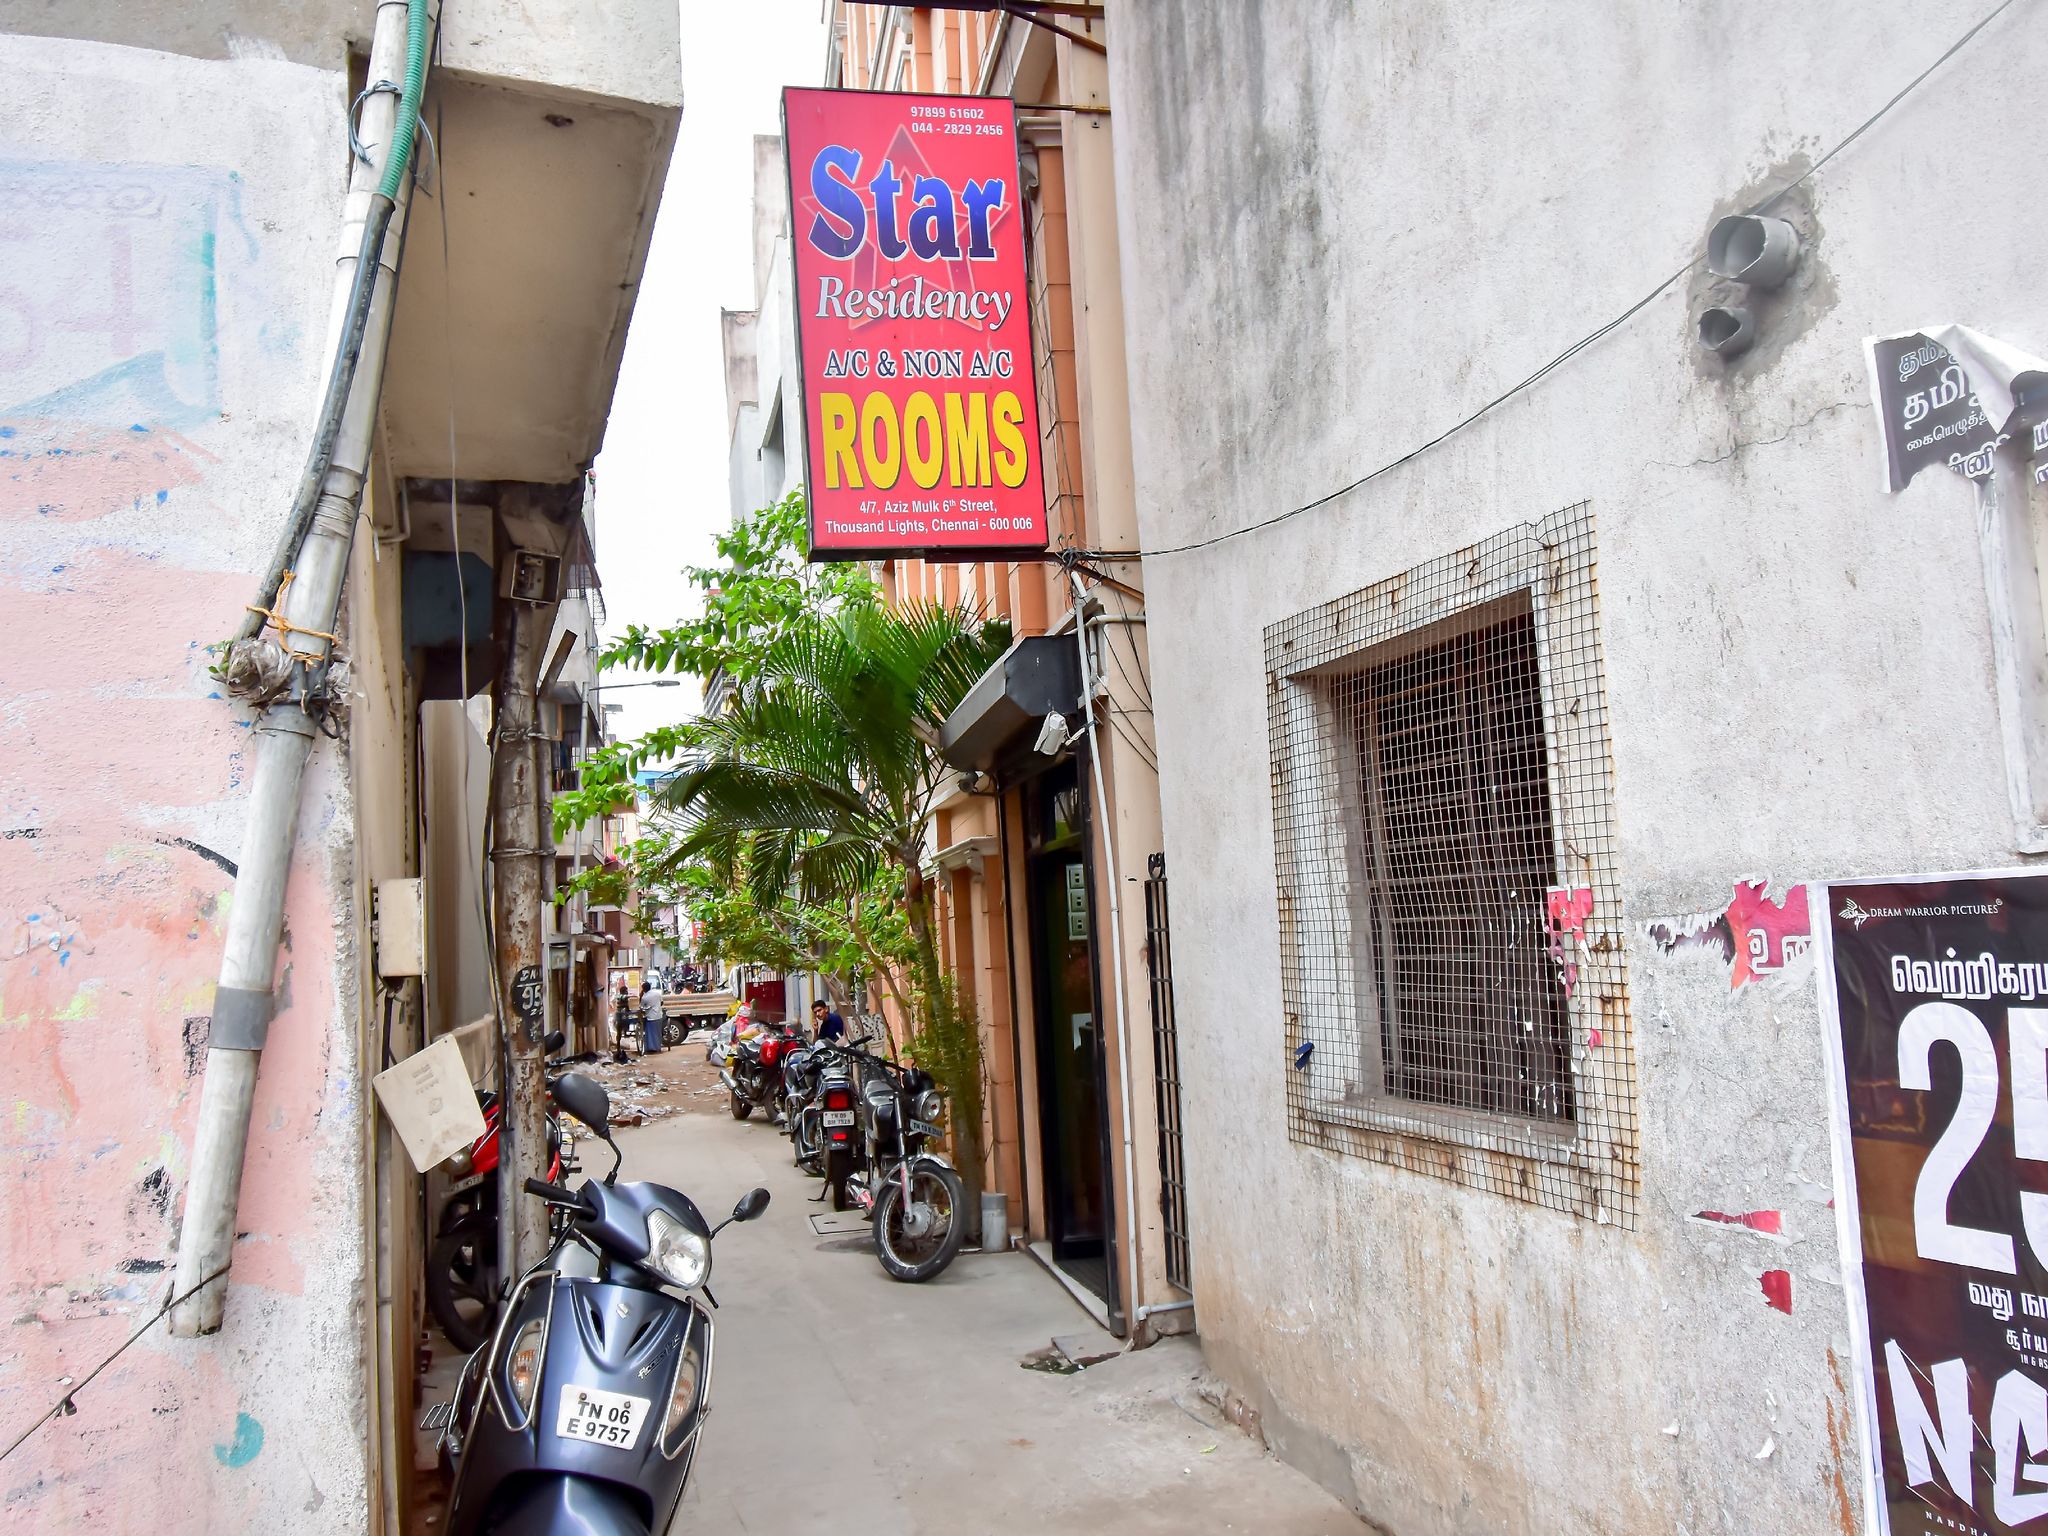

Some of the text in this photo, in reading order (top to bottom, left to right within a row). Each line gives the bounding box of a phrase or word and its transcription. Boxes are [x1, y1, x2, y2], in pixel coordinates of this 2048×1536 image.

[910, 106, 984, 119] 97899 61602
[911, 122, 933, 133] 044
[944, 124, 972, 135] 2829
[975, 125, 1003, 136] 2456
[808, 144, 1005, 262] Star
[815, 276, 1011, 330] Residency
[824, 350, 1013, 378] A/C & NON A/C
[820, 390, 1028, 490] ROOMS
[859, 501, 881, 515] 4/7,
[884, 501, 909, 513] Aziz
[912, 500, 939, 513] Mulk
[959, 499, 997, 513] Street,
[825, 520, 884, 534] Thousand
[888, 519, 929, 535] Lights,
[931, 517, 979, 531] Chennai
[989, 518, 1010, 530] 600
[1012, 517, 1033, 530] 006
[1870, 907, 1902, 917] DREAM
[1904, 906, 1949, 917] WARRIOR
[577, 1400, 631, 1425] TN 06
[566, 1418, 631, 1446] E 9757
